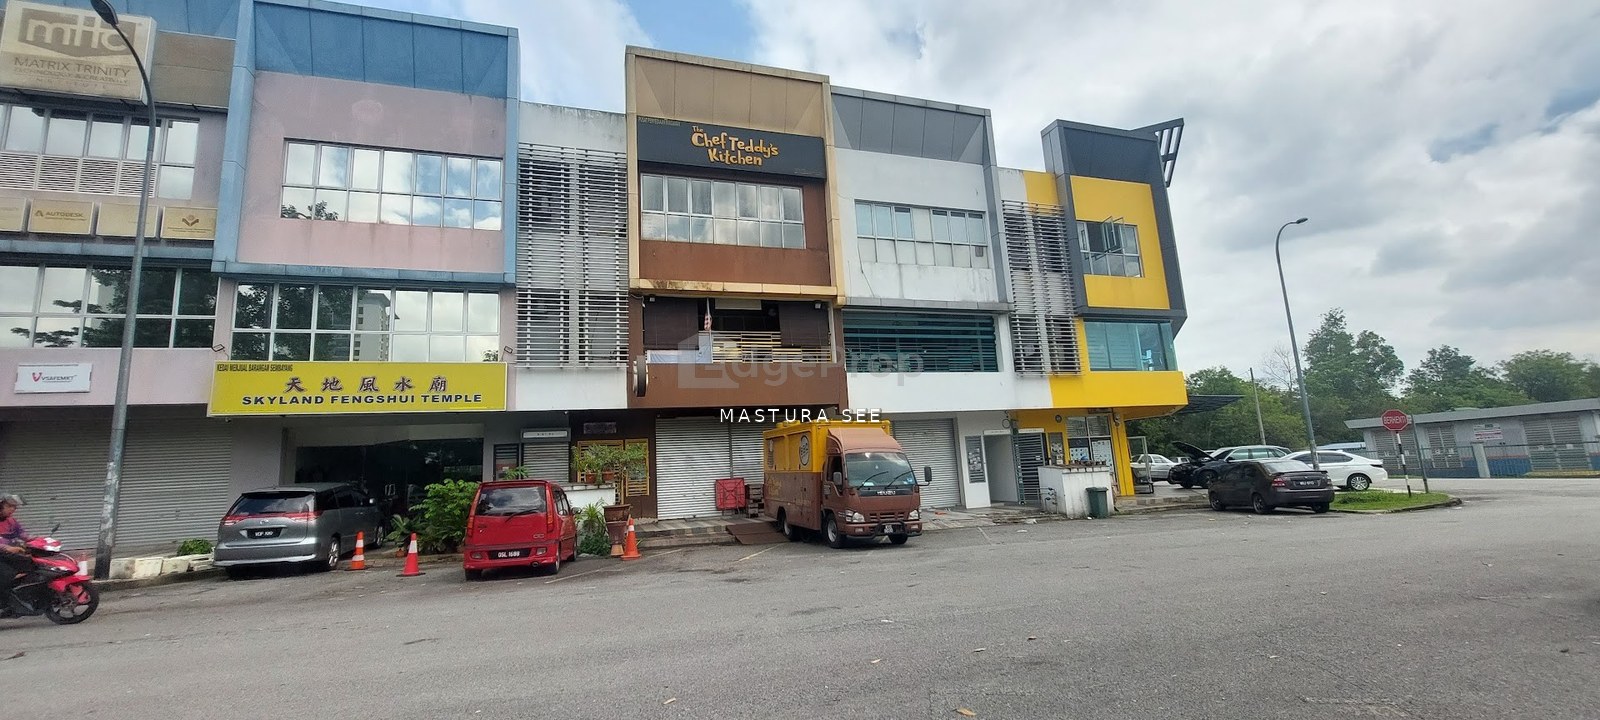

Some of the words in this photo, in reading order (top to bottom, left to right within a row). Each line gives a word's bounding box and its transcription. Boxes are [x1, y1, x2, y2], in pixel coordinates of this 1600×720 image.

[14, 57, 70, 71] MATRIX
[75, 63, 131, 77] TRINITY
[692, 125, 704, 133] The
[691, 132, 728, 150] Chef
[728, 136, 779, 159] Teddy's
[707, 148, 763, 166] Kitchen
[284, 376, 448, 393] 天地風水廟
[241, 396, 325, 405] SKYLAND
[330, 394, 415, 404] FENGSHUI
[420, 394, 482, 403] TEMPLE
